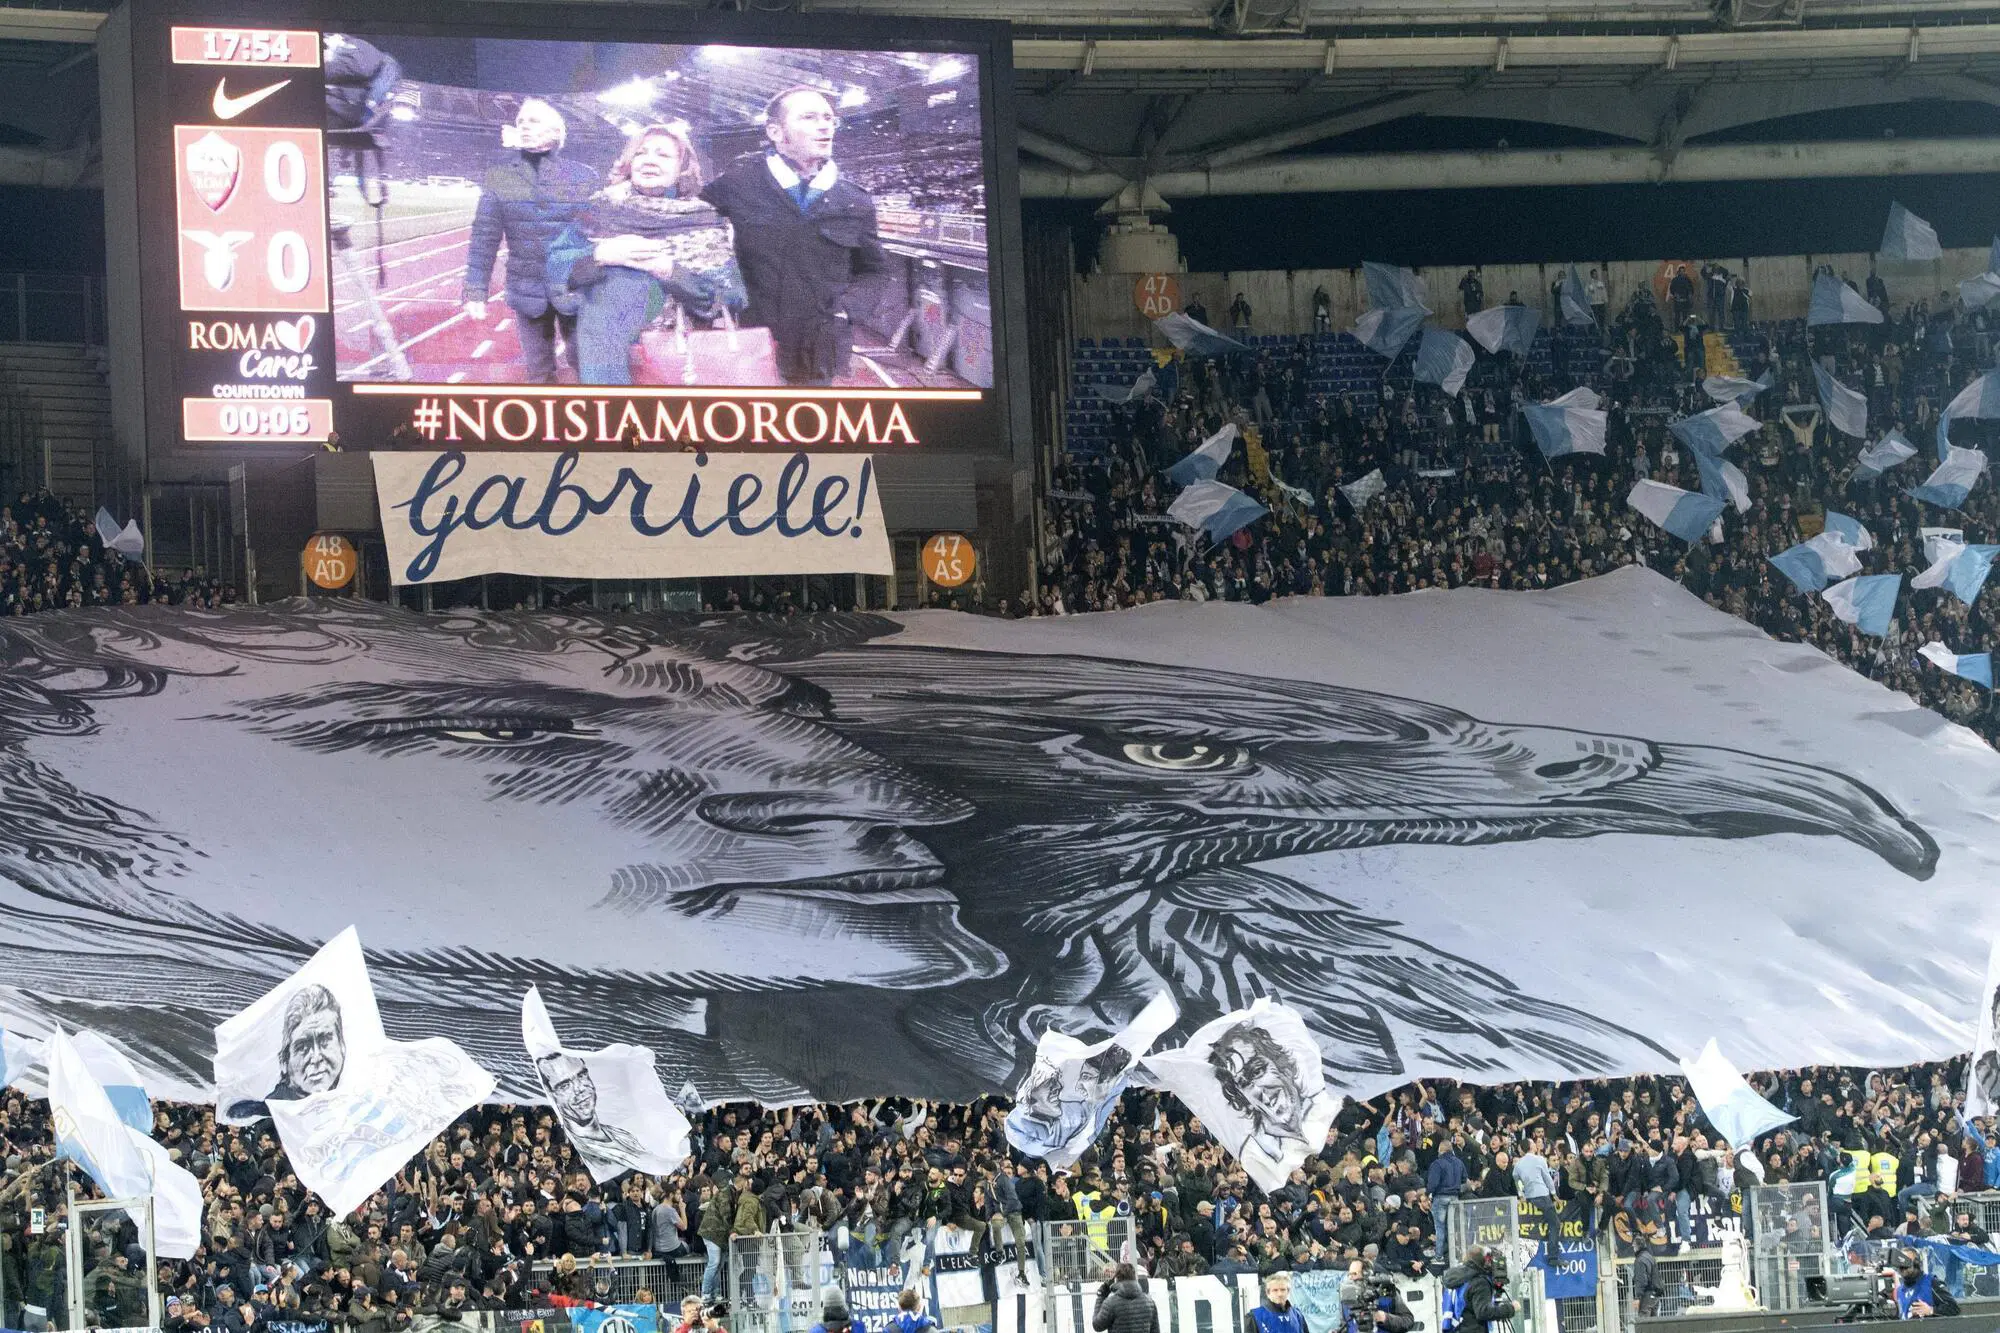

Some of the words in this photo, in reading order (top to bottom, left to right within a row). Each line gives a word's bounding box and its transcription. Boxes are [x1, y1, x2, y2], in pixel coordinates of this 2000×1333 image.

[203, 31, 292, 62] 17:54
[263, 141, 307, 203] 0
[267, 230, 310, 293] 0
[1145, 276, 1168, 294] 47
[1143, 295, 1172, 314] AD
[189, 321, 281, 350] ROMA
[239, 349, 318, 380] Cares
[212, 384, 305, 399] COUNTDOWN
[219, 404, 311, 435] 00:06
[413, 398, 919, 444] #NOISIAMOROMA
[315, 535, 342, 557] 48
[934, 536, 960, 557] 47
[314, 559, 346, 581] AD
[934, 559, 963, 580] AS
[1555, 1259, 1587, 1276] 1900
[1278, 1315, 1290, 1323] TV
